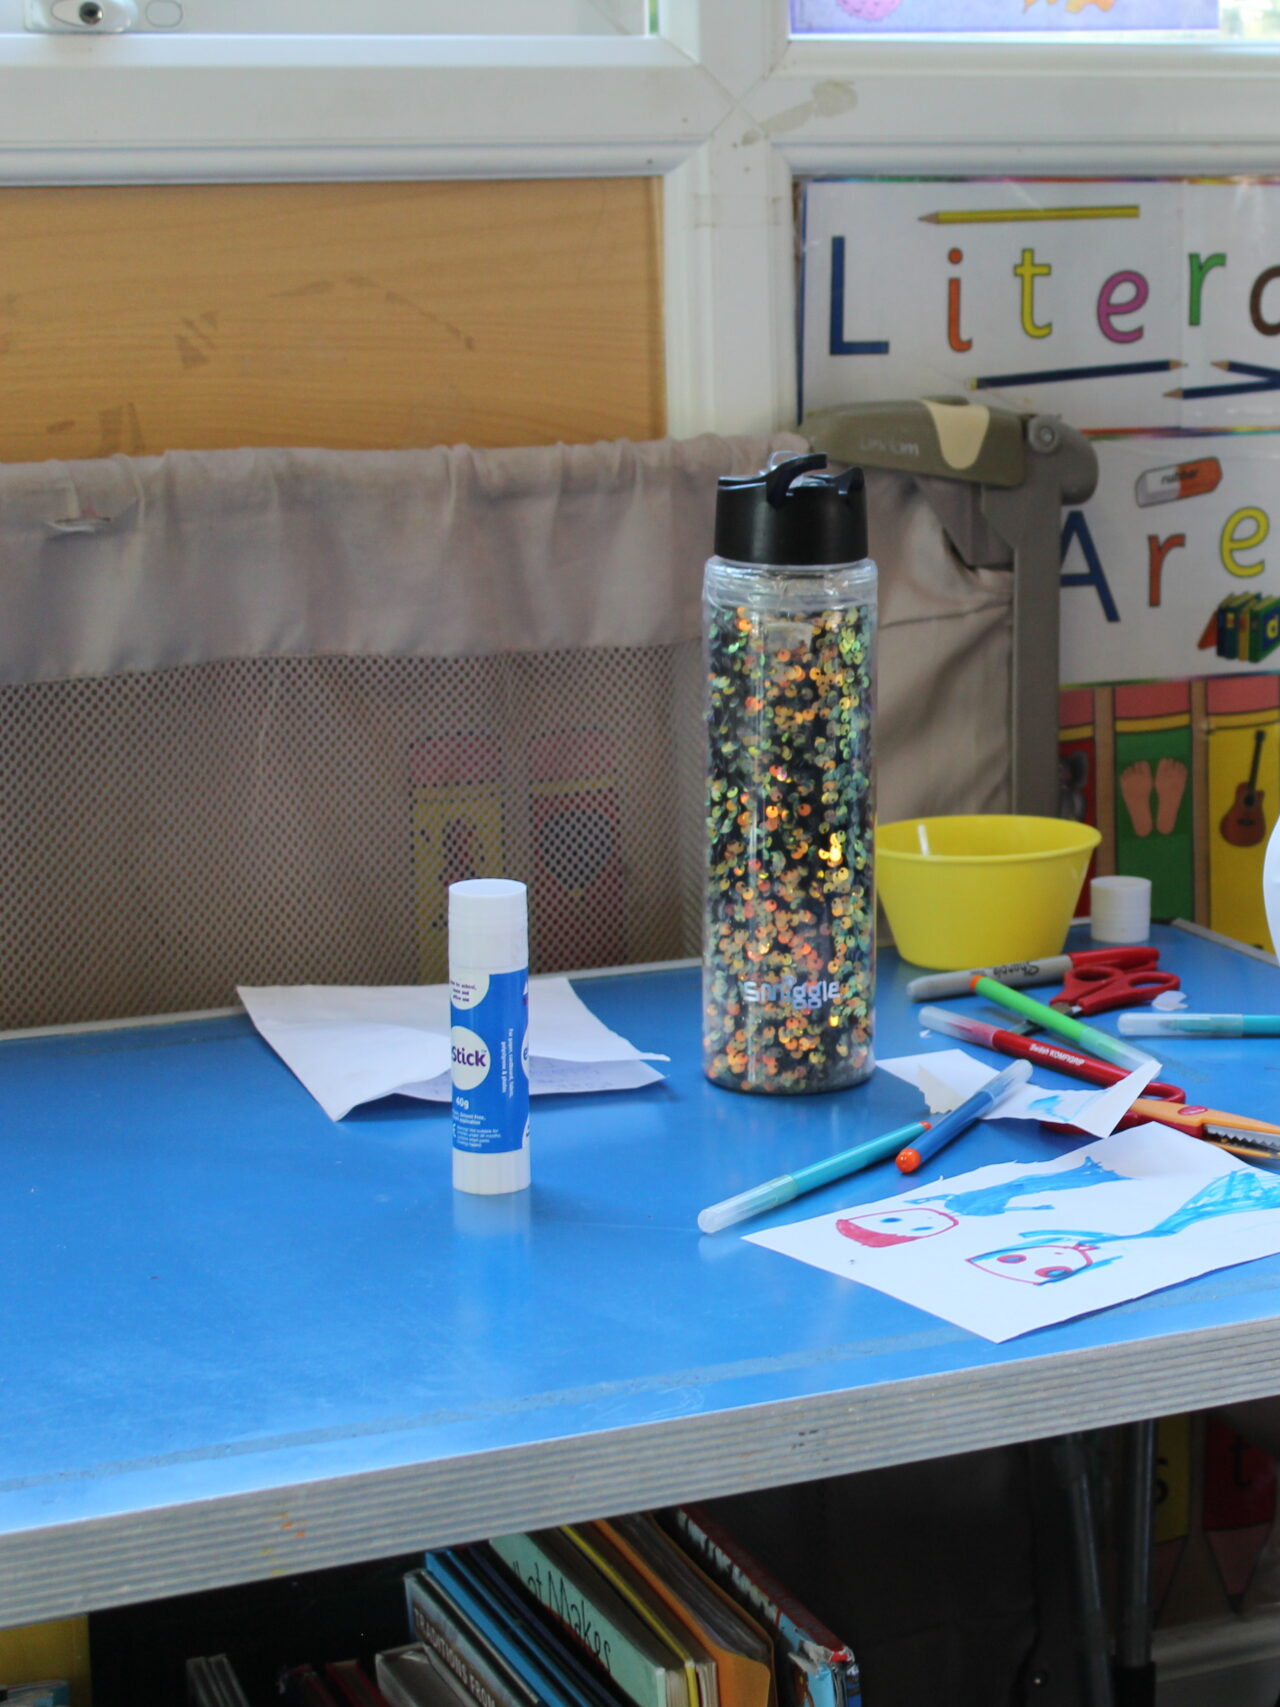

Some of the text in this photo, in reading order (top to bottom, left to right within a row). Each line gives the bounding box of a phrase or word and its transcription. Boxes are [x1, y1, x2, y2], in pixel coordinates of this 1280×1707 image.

[451, 1046, 486, 1067] Stick
[456, 1096, 469, 1110] 40g
[413, 1608, 468, 1687] TRADITIONS
